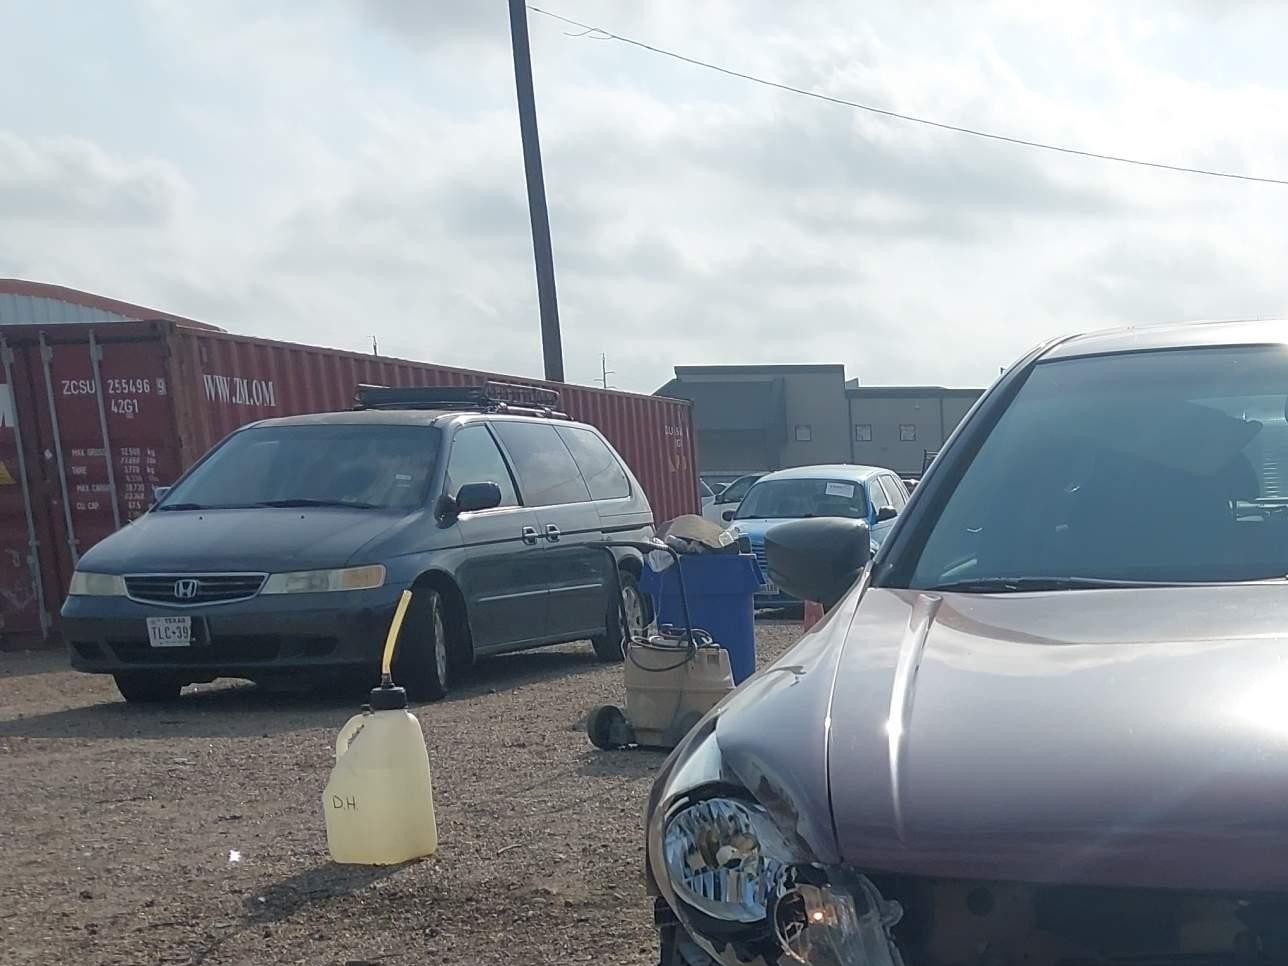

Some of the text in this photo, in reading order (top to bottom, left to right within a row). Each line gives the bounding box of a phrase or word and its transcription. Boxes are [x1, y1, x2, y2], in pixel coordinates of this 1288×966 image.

[61, 380, 95, 394] ZCSU
[107, 379, 150, 393] 255496
[112, 400, 138, 413] 42G1
